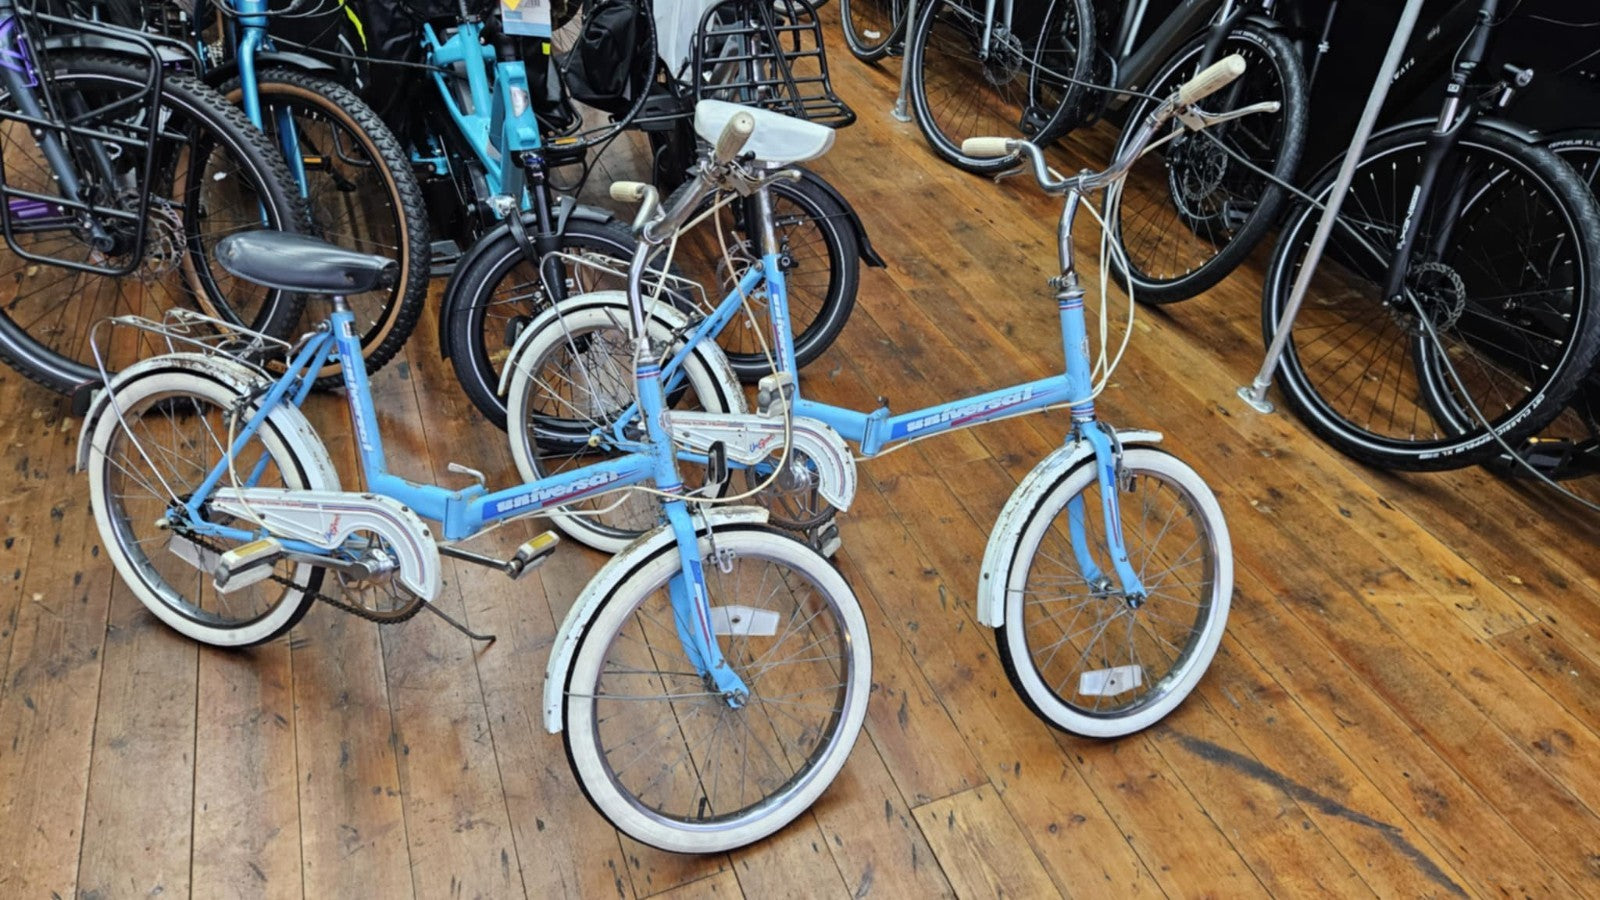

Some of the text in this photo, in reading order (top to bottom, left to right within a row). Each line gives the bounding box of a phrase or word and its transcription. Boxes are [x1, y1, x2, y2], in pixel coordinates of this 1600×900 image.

[772, 293, 790, 372] universa
[906, 386, 1033, 432] universal
[496, 470, 620, 513] universal
